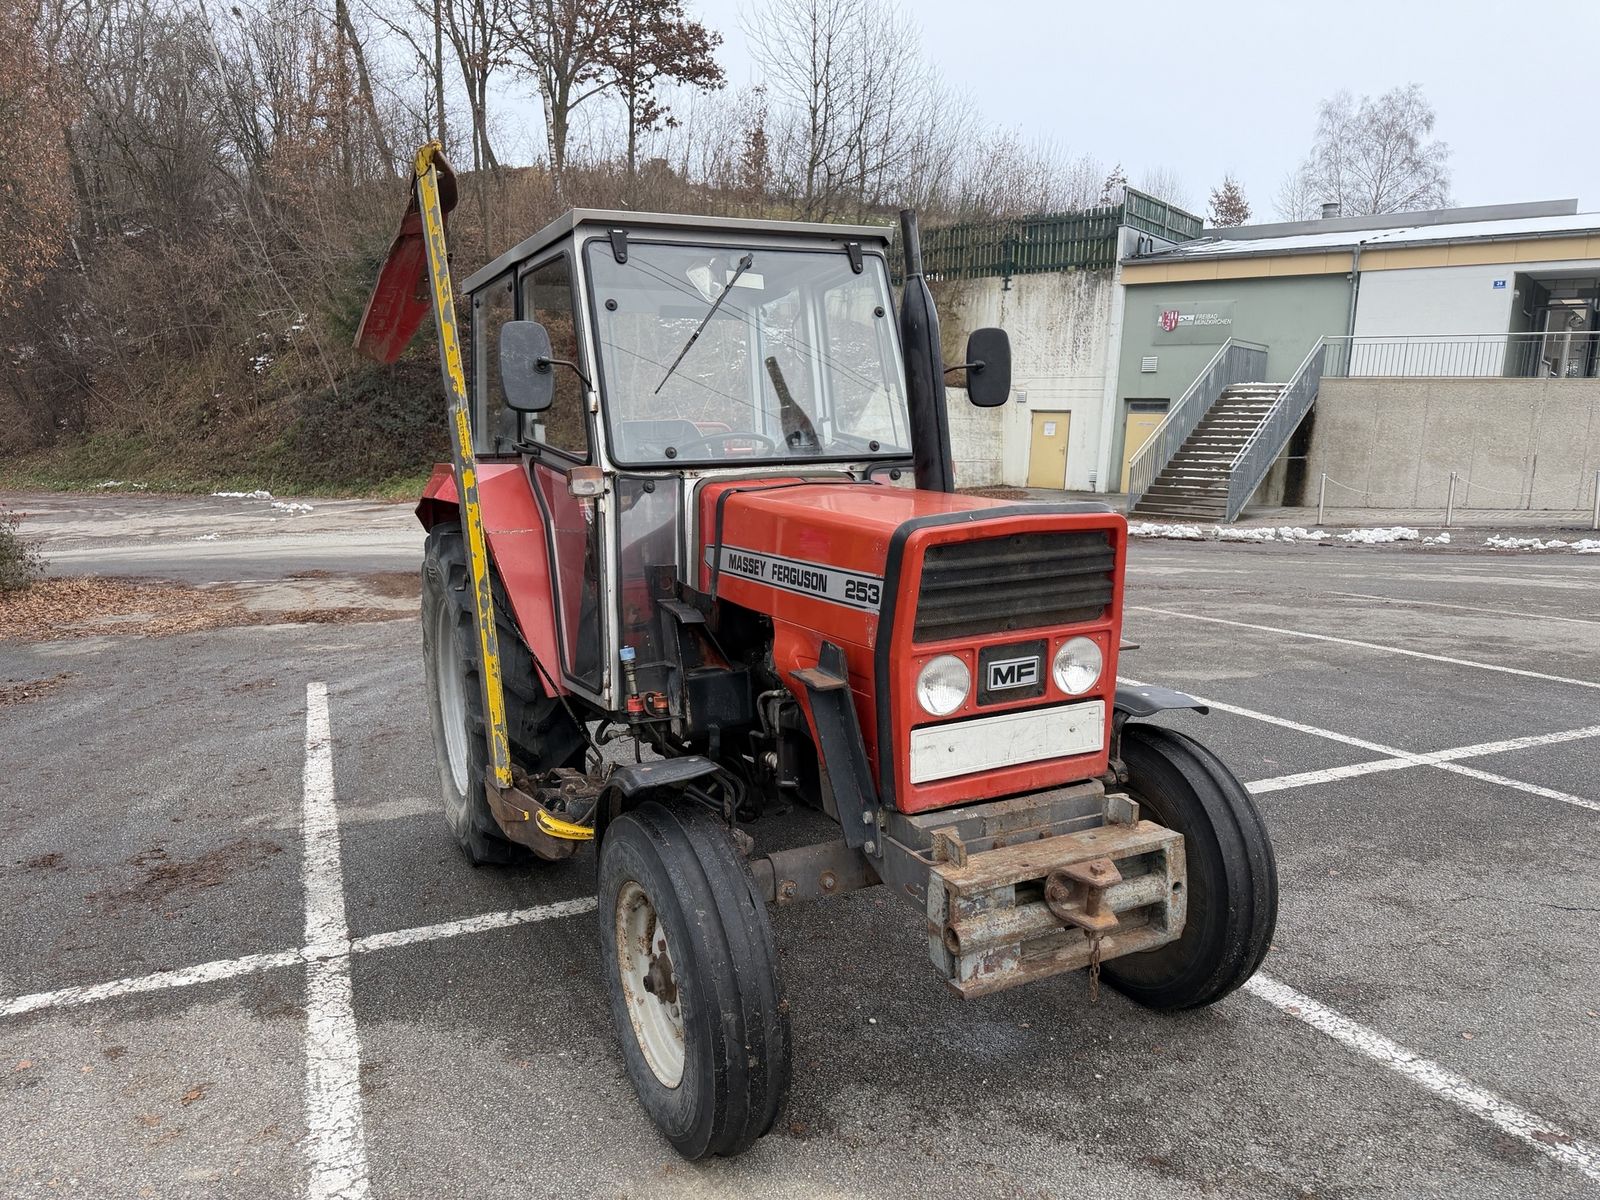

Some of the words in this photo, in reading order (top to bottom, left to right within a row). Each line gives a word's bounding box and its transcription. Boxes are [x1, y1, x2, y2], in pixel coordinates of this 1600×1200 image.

[728, 553, 767, 577] MASSEY
[771, 563, 828, 593] FERGUSON
[845, 579, 880, 605] 253
[993, 662, 1036, 686] MF
